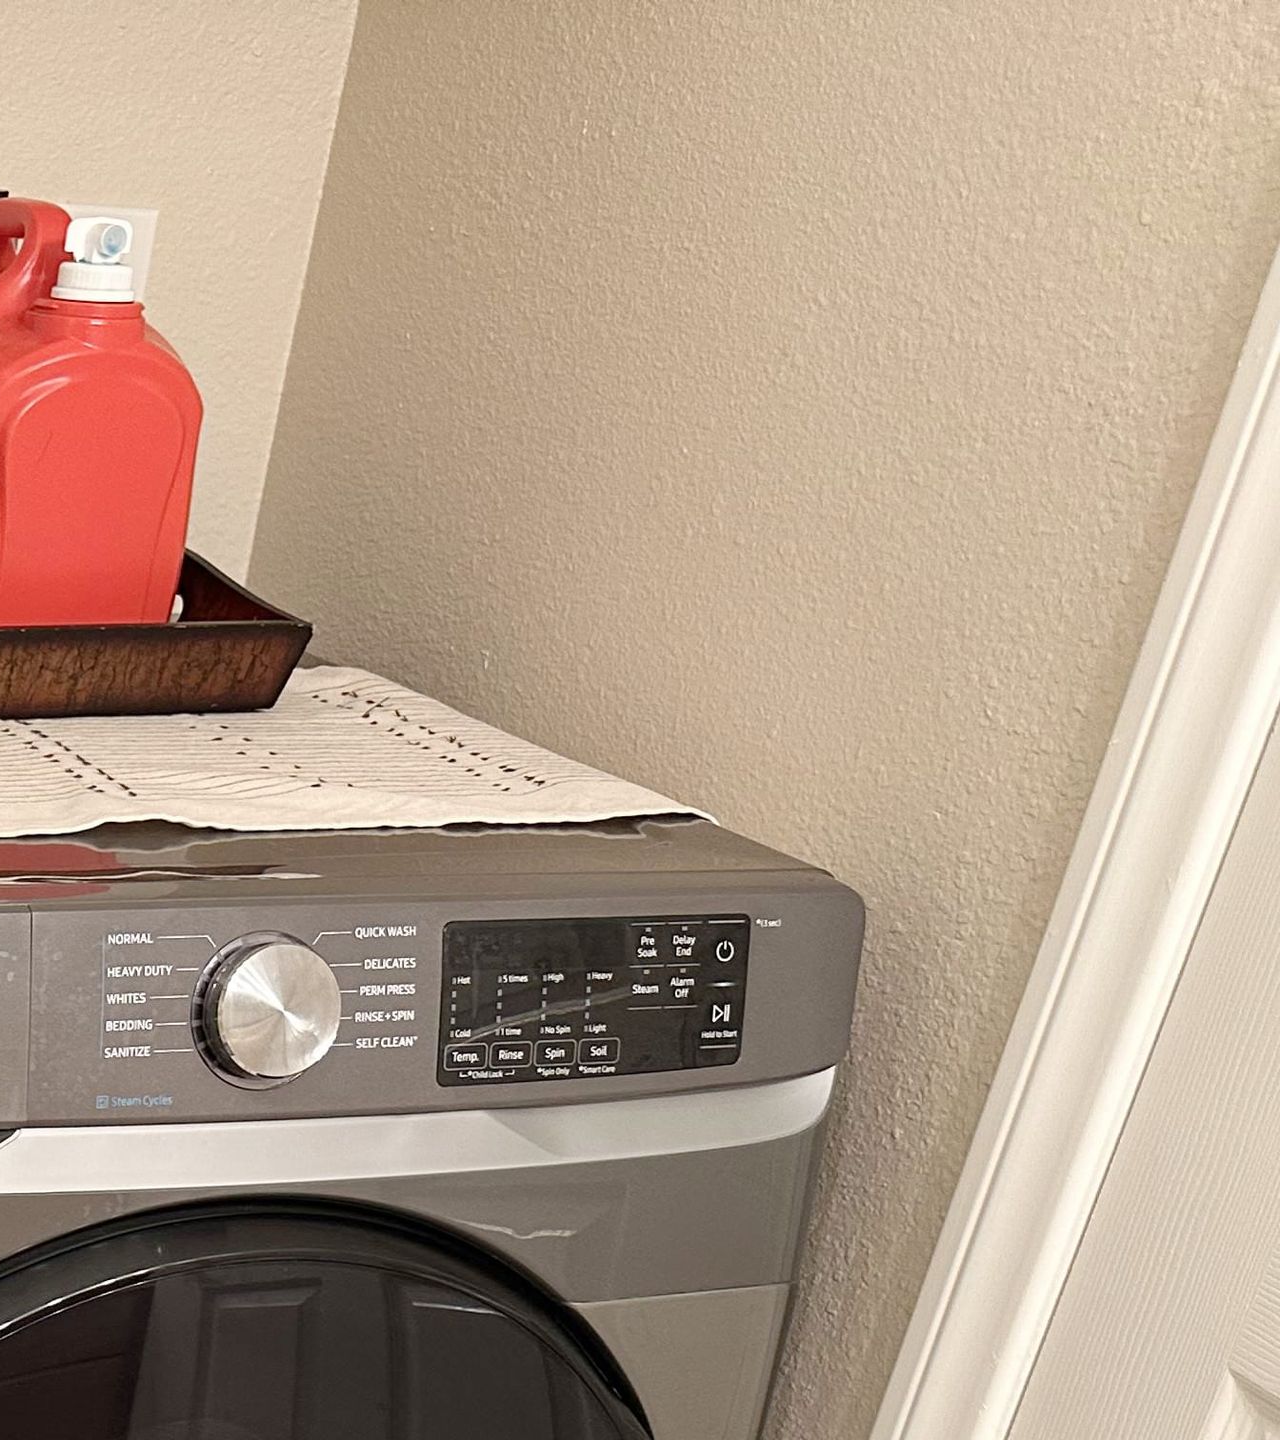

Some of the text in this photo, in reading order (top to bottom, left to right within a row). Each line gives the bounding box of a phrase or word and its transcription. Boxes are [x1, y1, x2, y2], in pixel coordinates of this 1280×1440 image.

[354, 926, 416, 939] QUICK WASH
[107, 934, 153, 945] NORMAL
[640, 936, 655, 946] Pre
[672, 935, 696, 946] Delay
[637, 947, 657, 958] Soak
[675, 946, 692, 957] End
[364, 958, 416, 970] DELICATES
[107, 965, 172, 978] HEAVY DUTY
[591, 971, 613, 981] Heavy
[457, 976, 471, 985] Hot
[508, 974, 529, 983] times
[547, 973, 564, 982] High
[670, 977, 694, 987] Alarm
[359, 985, 416, 997] PERM PRESS
[632, 984, 659, 995] Steam
[674, 988, 689, 999] Off
[106, 993, 146, 1004] WHITES
[105, 1019, 153, 1031] BEDDING
[544, 1025, 571, 1036] No Spin
[589, 1024, 607, 1034] Light
[455, 1028, 471, 1038] Cold
[505, 1027, 522, 1036] time
[701, 1030, 715, 1039] Hold
[723, 1029, 738, 1038] Start
[355, 1037, 379, 1049] SELF
[104, 1046, 151, 1058] SANITIZE
[498, 1049, 524, 1060] Rinse
[544, 1047, 565, 1060] Spin
[589, 1045, 608, 1057] Soil
[452, 1051, 479, 1064] Temp.
[471, 1070, 488, 1079] Child
[554, 1066, 570, 1077] Only
[583, 1065, 616, 1075] Smart Care
[111, 1095, 173, 1108] Steam Cycles
